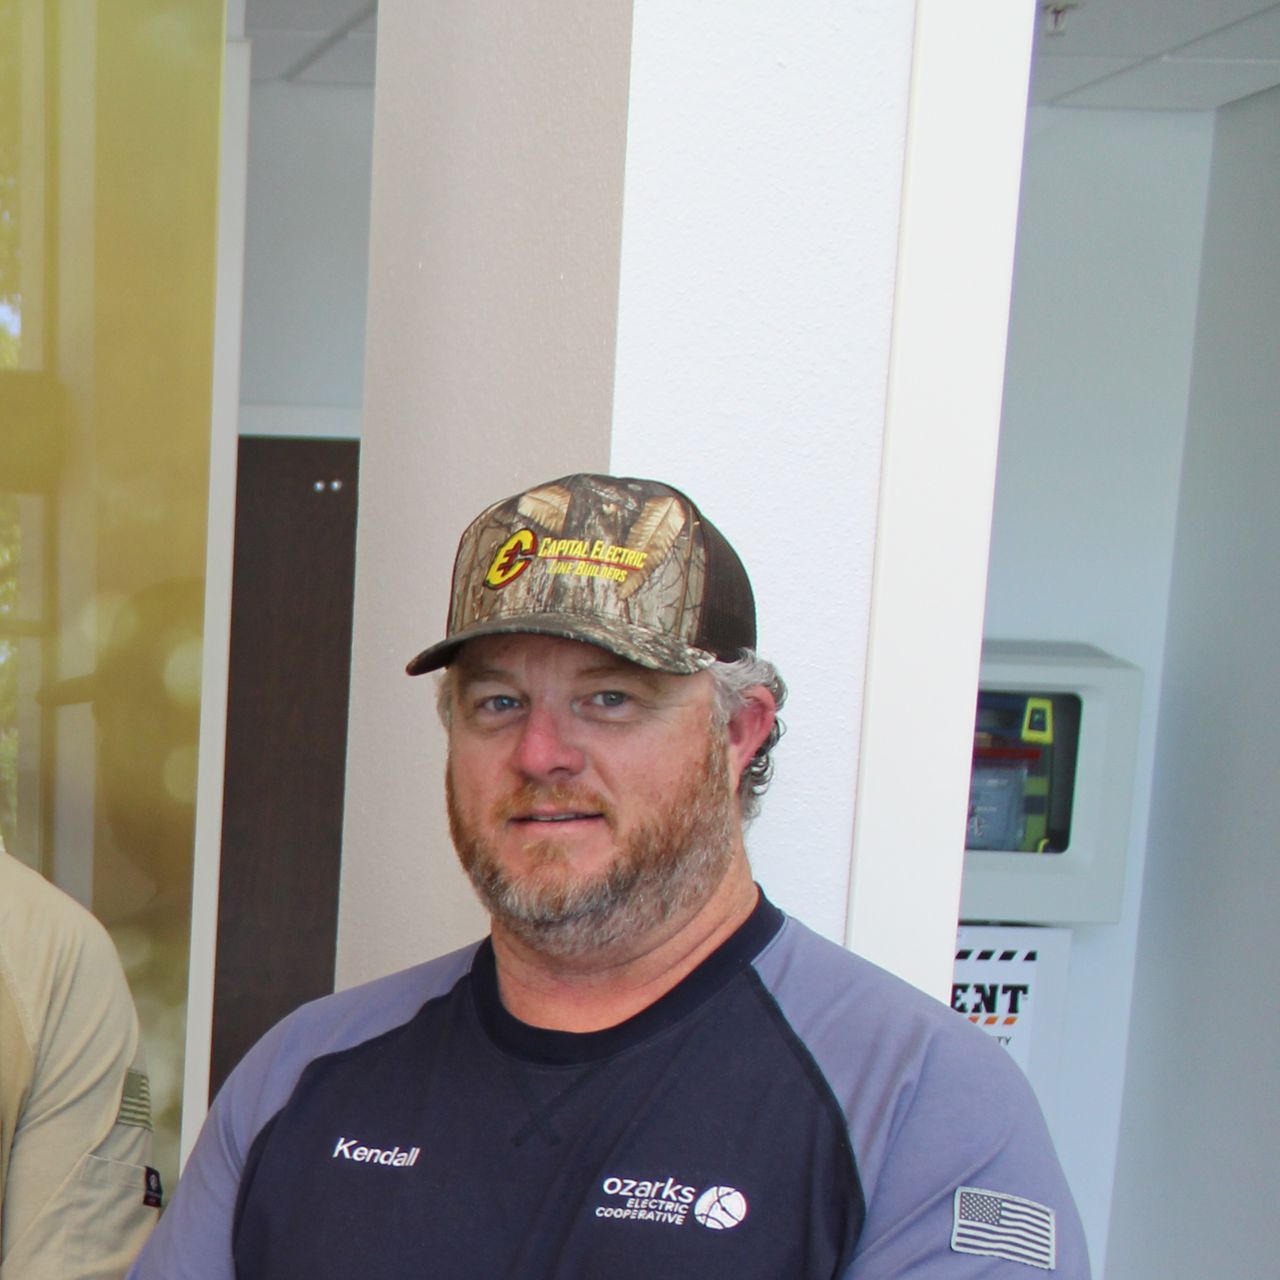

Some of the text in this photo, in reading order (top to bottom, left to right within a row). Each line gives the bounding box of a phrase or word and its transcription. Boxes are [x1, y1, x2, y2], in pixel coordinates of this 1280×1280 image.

[538, 537, 648, 568] CAPITAL ELECTRIC
[548, 560, 628, 582] LINE BUILDERS
[333, 1137, 420, 1167] Kendall
[602, 1176, 696, 1202] ozarks
[595, 1206, 685, 1225] COOPERATIVE
[626, 1198, 689, 1215] ELECTRIC
